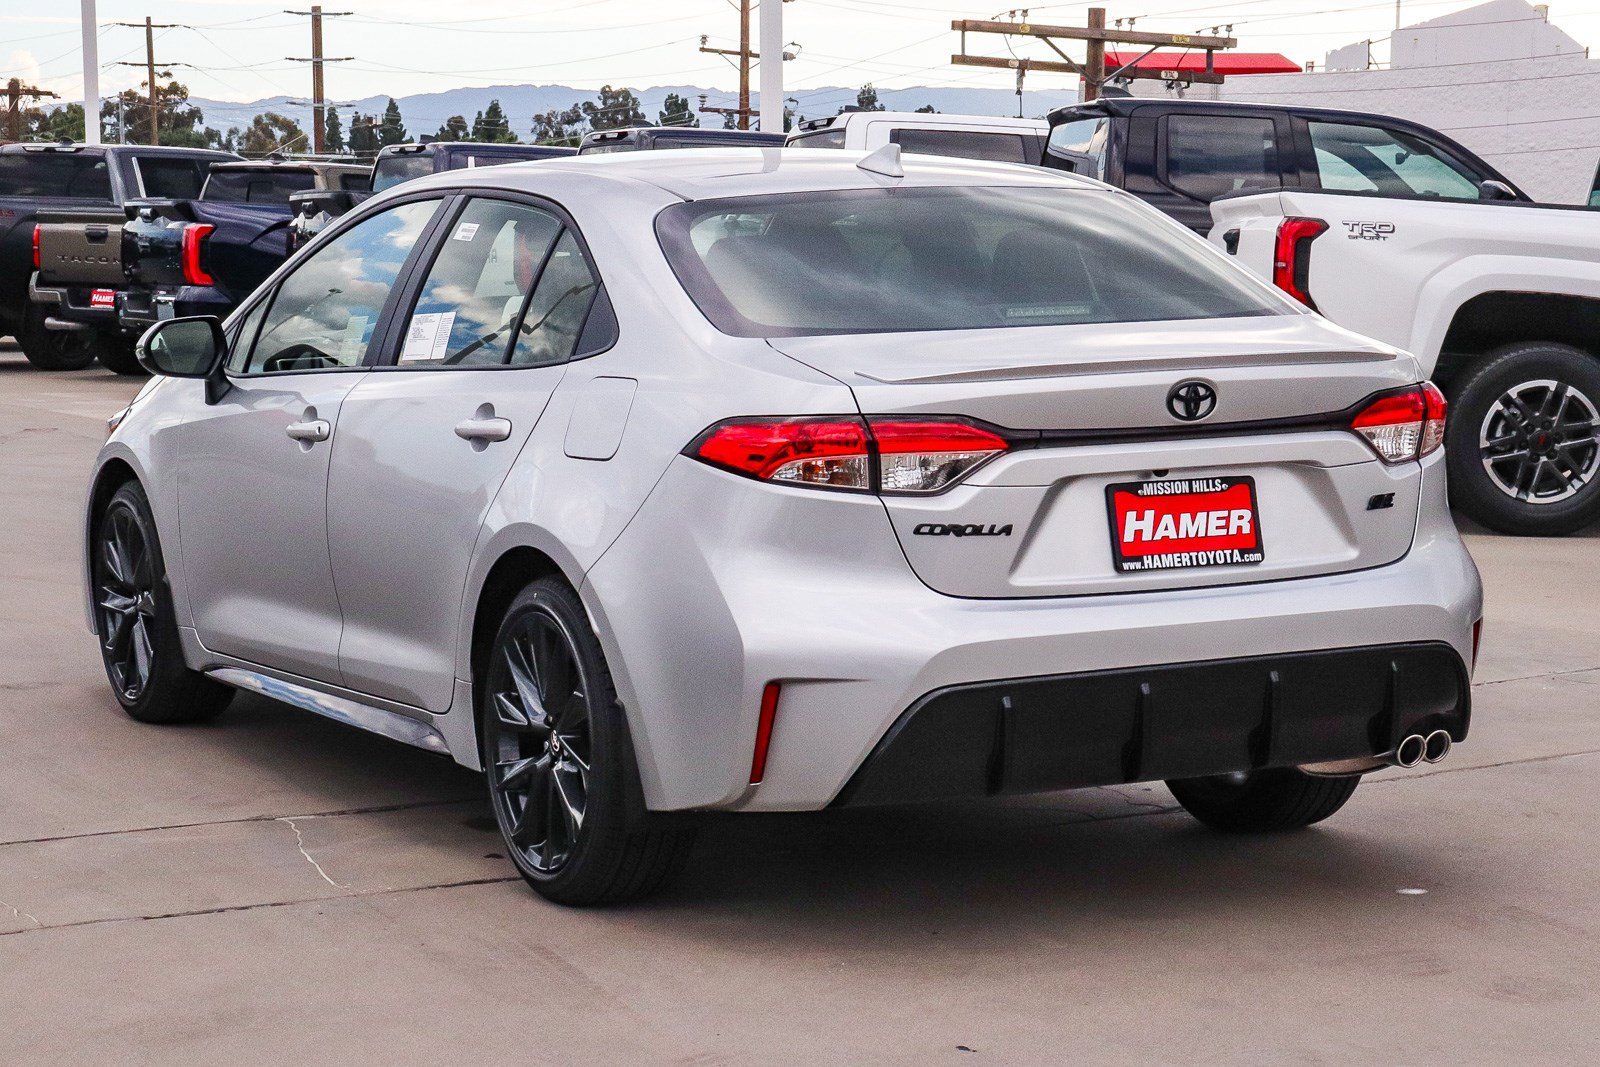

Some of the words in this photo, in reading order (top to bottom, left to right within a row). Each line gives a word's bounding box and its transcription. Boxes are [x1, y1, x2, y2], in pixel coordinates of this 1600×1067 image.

[1342, 220, 1395, 236] TRD
[57, 255, 120, 264] TACOM
[1143, 481, 1190, 496] MISSION
[1192, 479, 1222, 493] HILLS
[912, 523, 1014, 538] COROLLA
[1123, 508, 1252, 543] HAMER
[1122, 550, 1262, 570] www.HAMERTOYOTA.com
